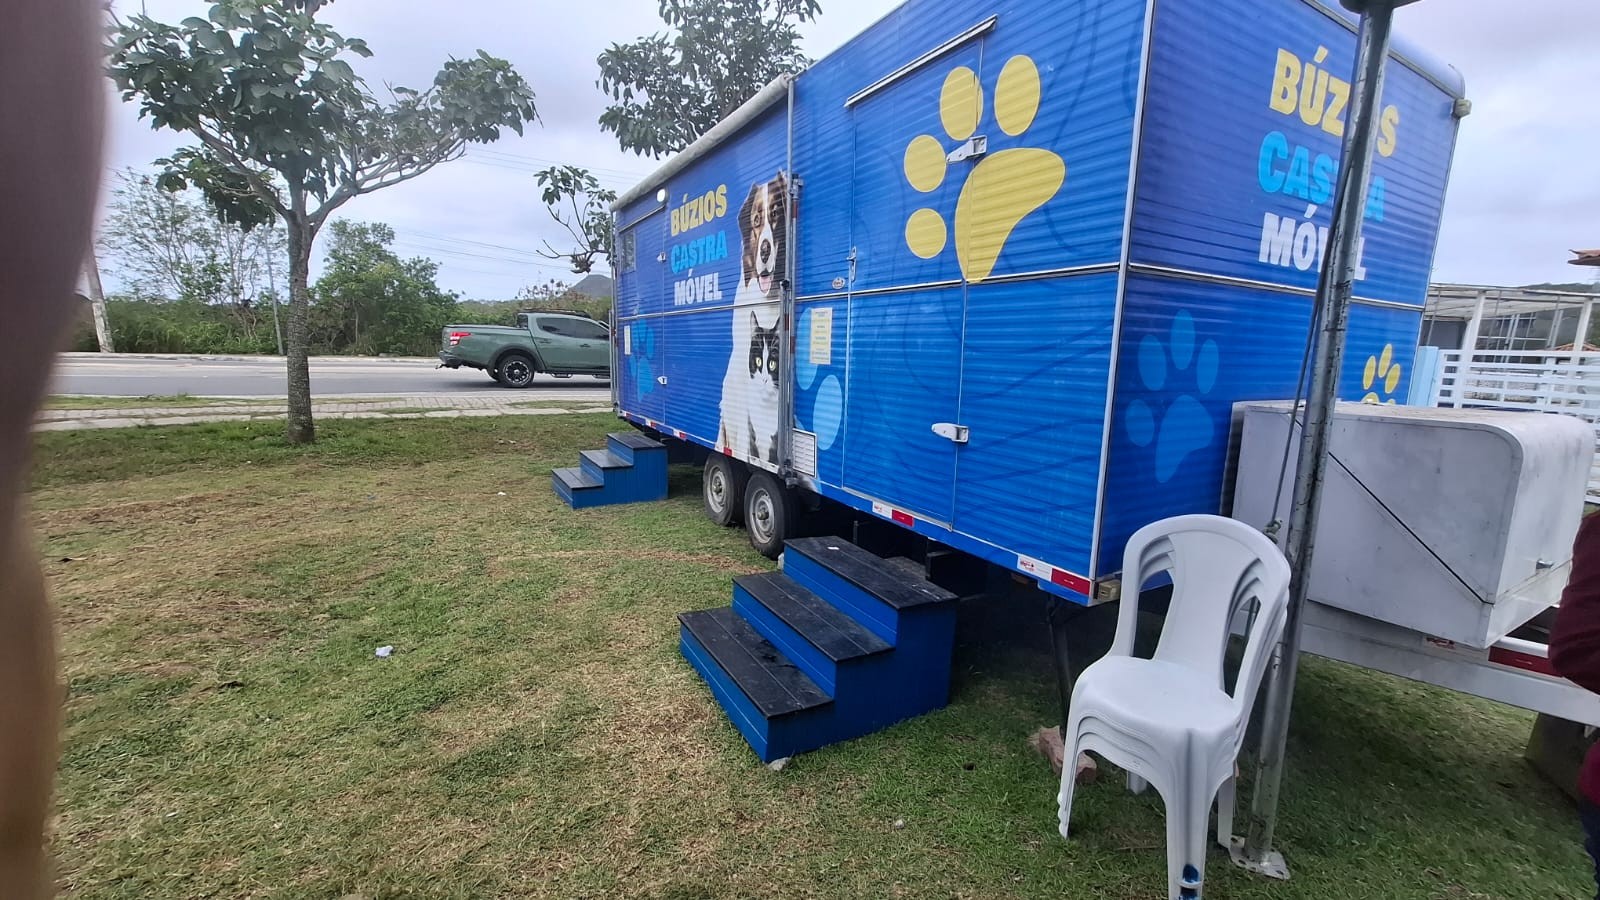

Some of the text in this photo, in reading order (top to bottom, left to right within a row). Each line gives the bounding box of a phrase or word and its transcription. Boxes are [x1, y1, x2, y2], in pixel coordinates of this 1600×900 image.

[1269, 45, 1399, 158] BÚZS
[1258, 131, 1385, 222] CASA
[671, 184, 728, 237] BÚZIOS
[671, 230, 728, 275] CASTRA
[674, 268, 723, 306] MÓVEL
